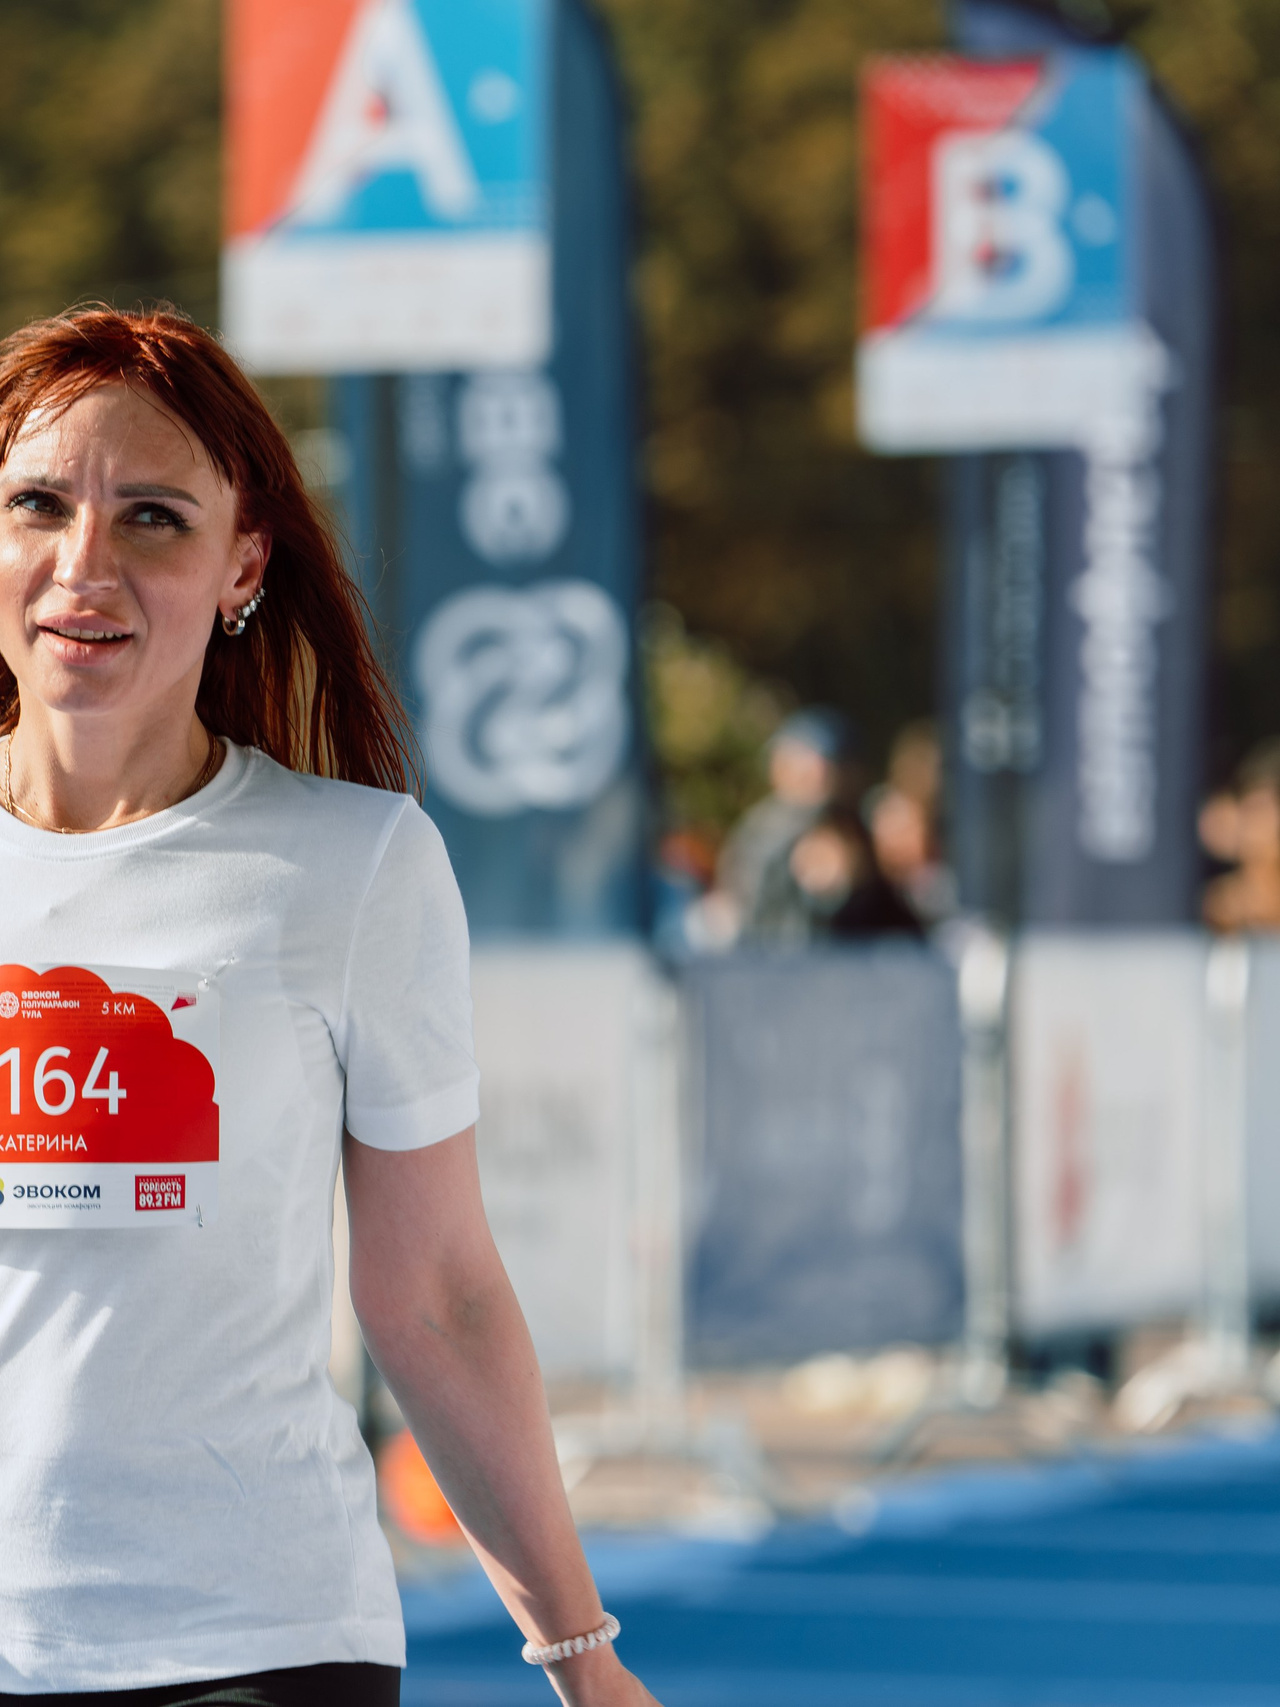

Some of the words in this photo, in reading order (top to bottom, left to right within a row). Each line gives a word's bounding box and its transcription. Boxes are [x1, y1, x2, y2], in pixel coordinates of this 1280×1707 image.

[21, 990, 60, 1000] ЭВОКОМ
[21, 1000, 80, 1009] ПОЛУМАРАФОН
[101, 1002, 110, 1015] 5
[21, 1010, 42, 1019] ТУЛА
[12, 1184, 101, 1199] ЭВОКОМ
[139, 1181, 182, 1193] ГОРДОСТЬ
[138, 1193, 163, 1208] 89.2
[164, 1192, 181, 1207] FM
